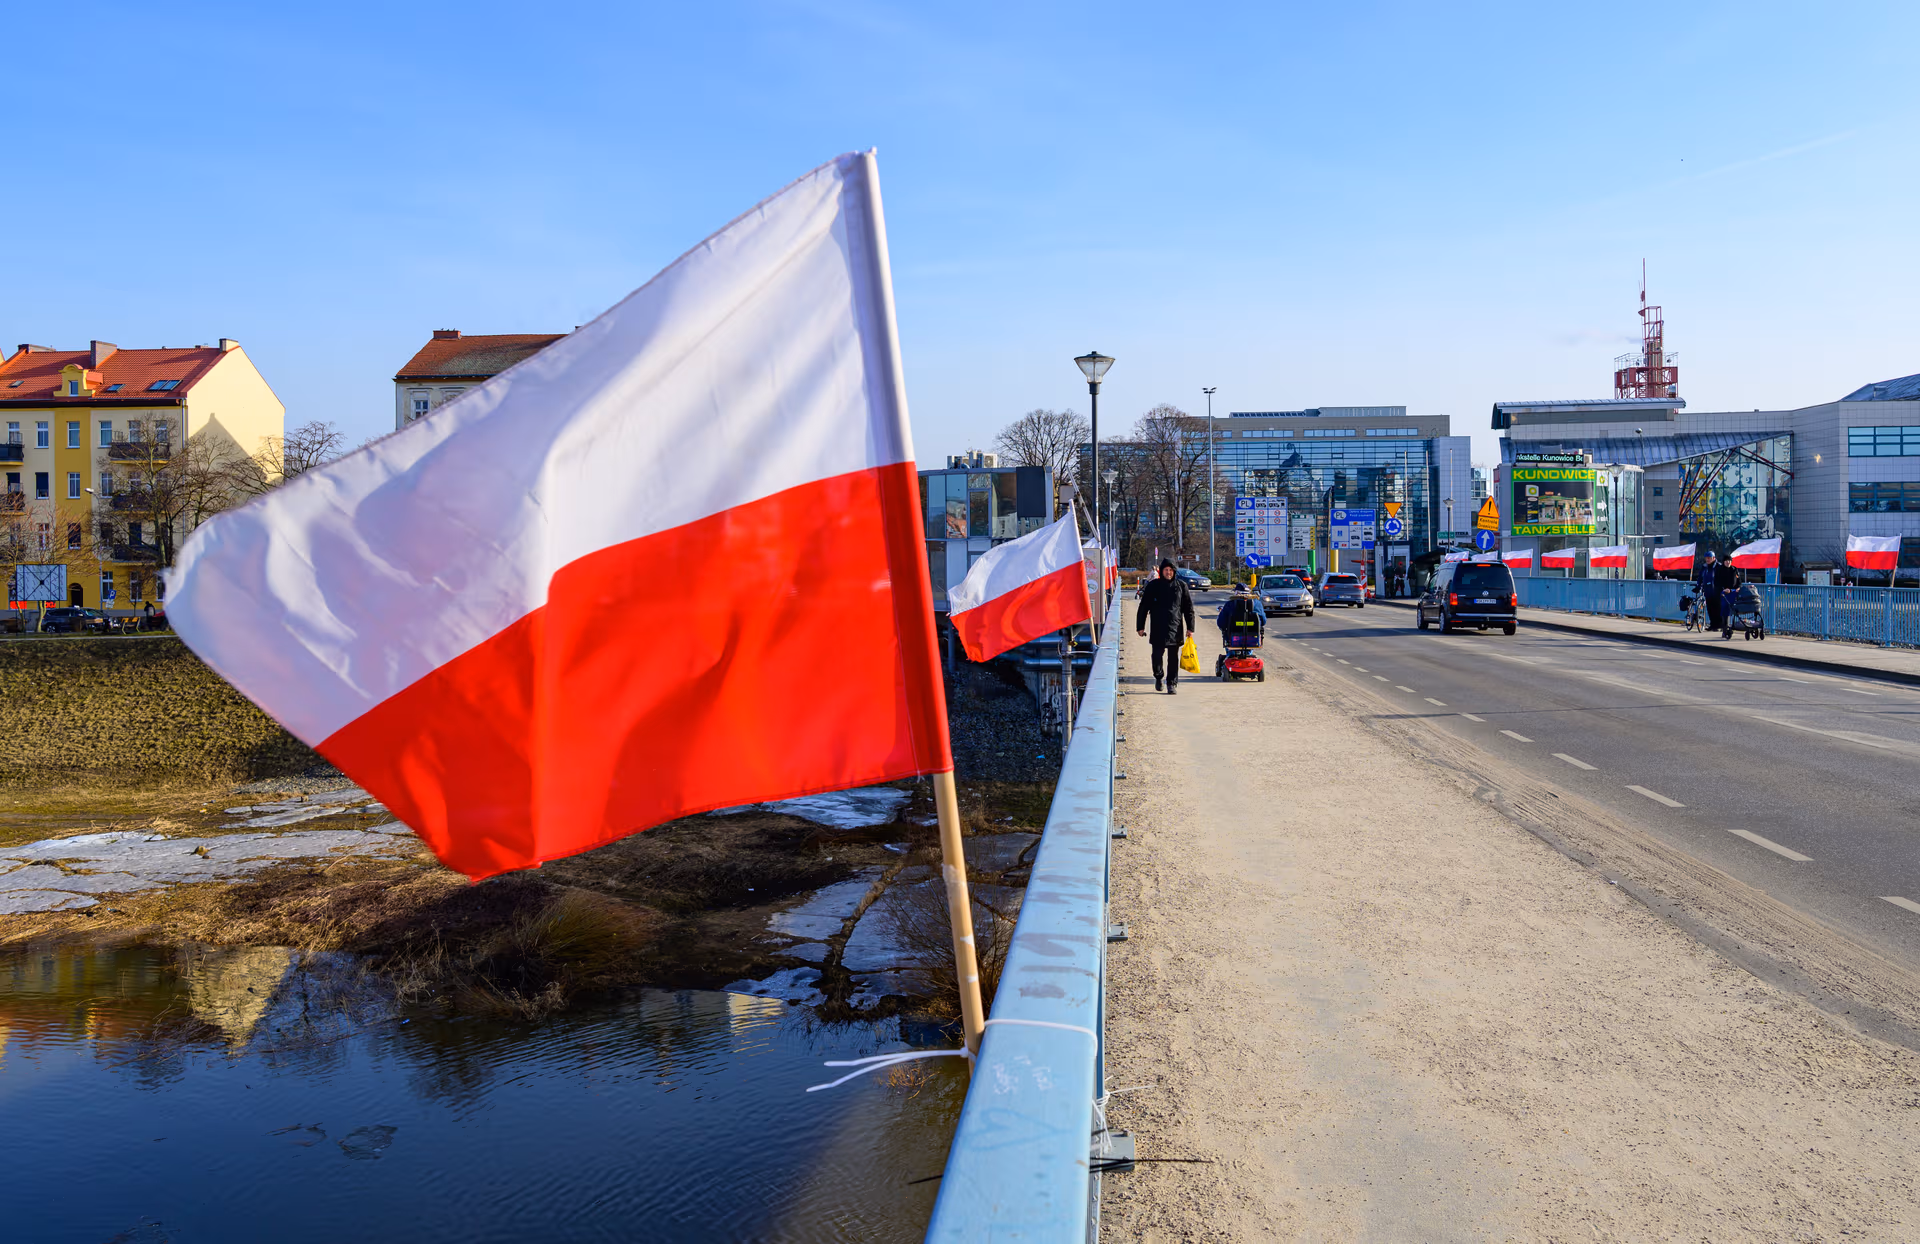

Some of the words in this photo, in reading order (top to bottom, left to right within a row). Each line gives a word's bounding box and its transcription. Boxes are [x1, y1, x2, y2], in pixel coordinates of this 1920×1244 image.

[1542, 454, 1574, 462] Kunowice
[1513, 470, 1596, 480] KUNOWICE
[1513, 525, 1596, 535] TANKSTELLE
[109, 590, 115, 598] P
